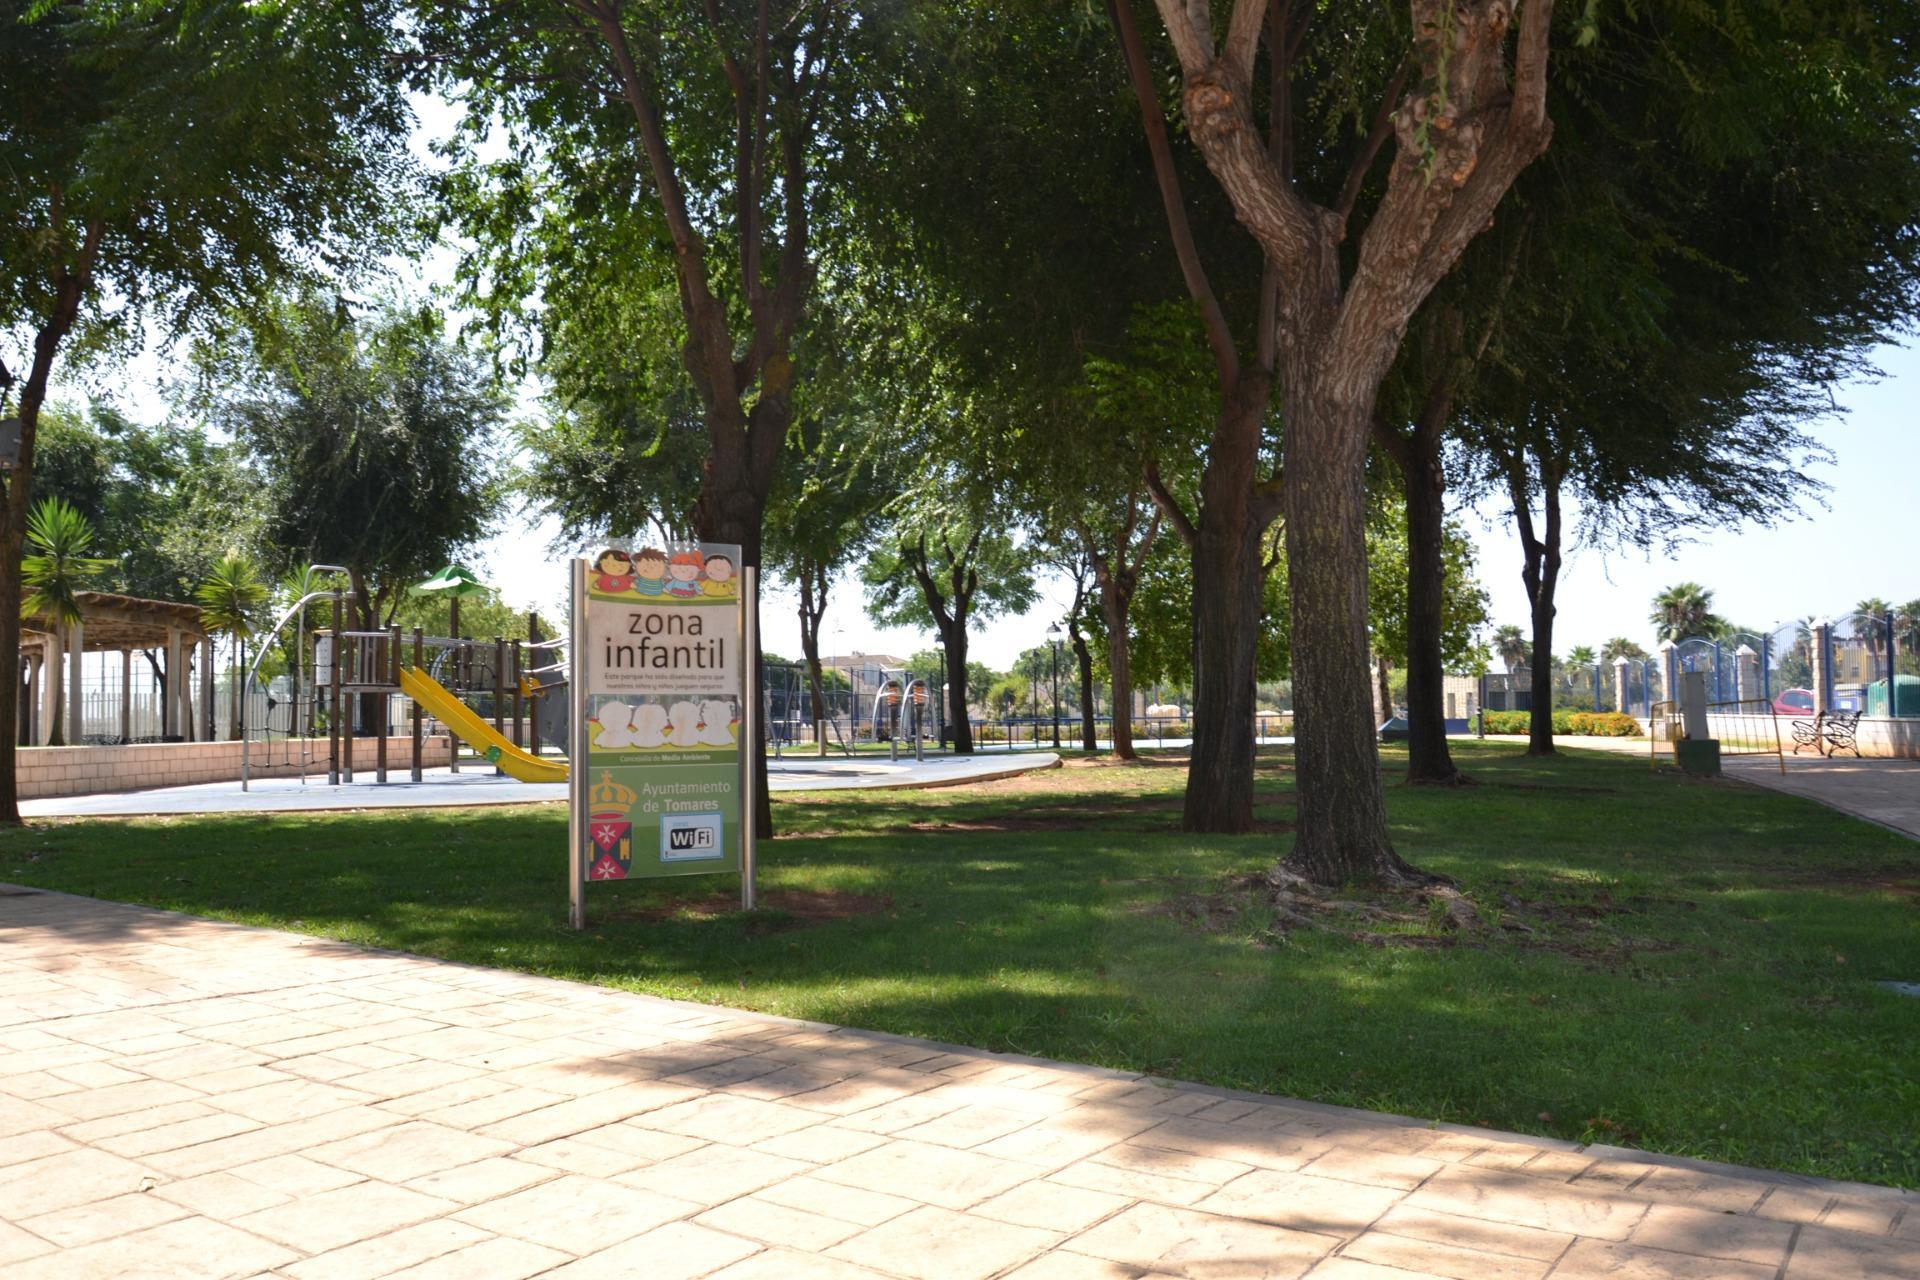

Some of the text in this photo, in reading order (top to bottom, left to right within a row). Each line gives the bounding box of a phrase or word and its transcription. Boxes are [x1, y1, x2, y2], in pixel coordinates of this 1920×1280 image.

[628, 613, 703, 636] zona
[605, 637, 724, 669] infantil
[620, 674, 644, 682] parque
[661, 753, 681, 761] Medio
[683, 753, 711, 761] Ambiente
[642, 781, 731, 798] Ayuntamiento
[643, 799, 719, 813] de Tomares
[672, 831, 710, 847] WiFi
